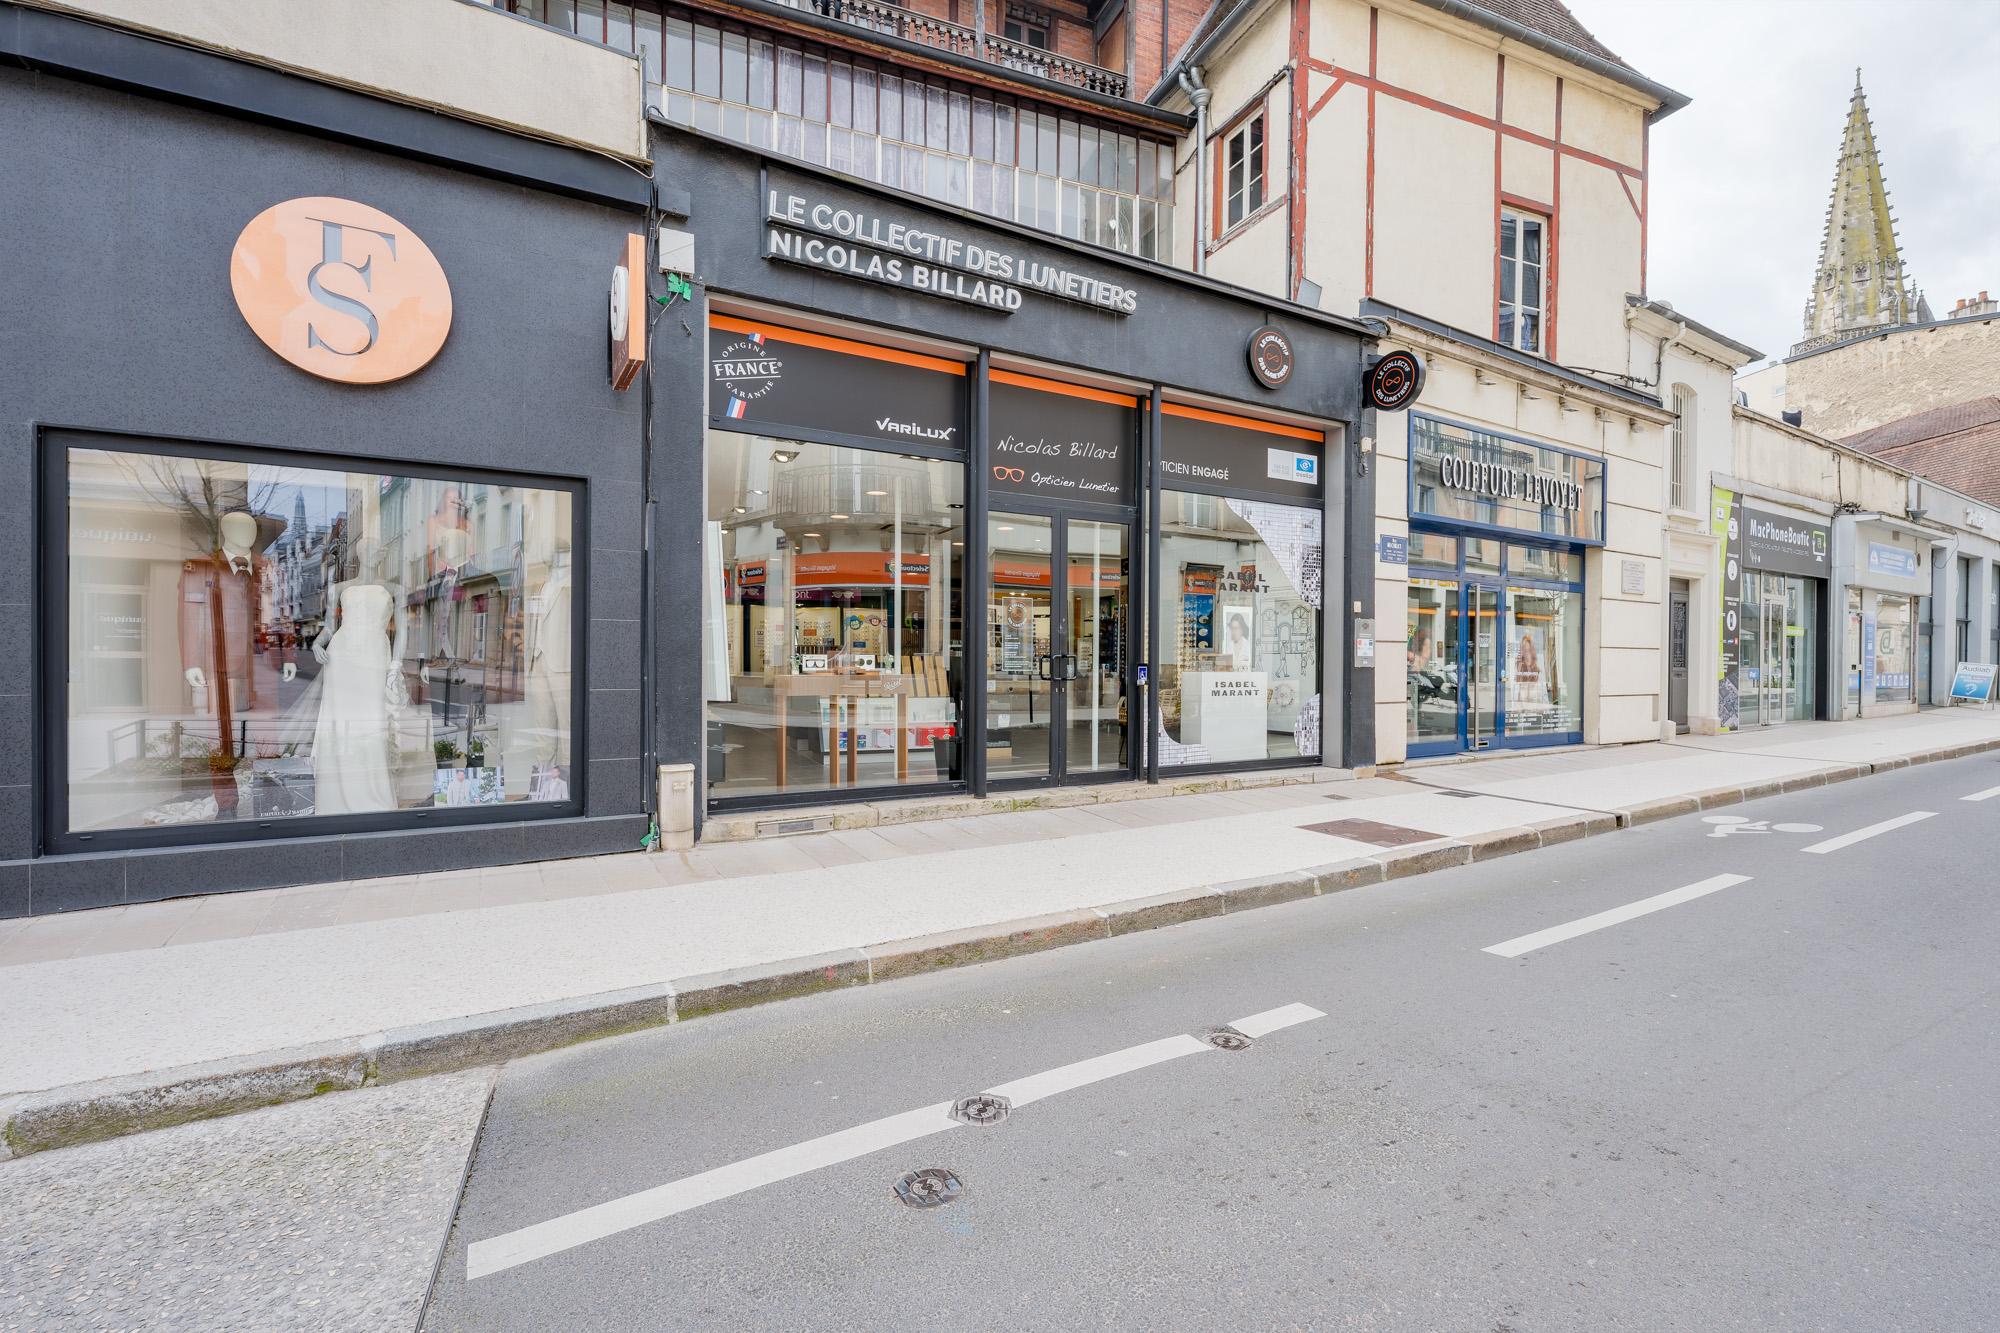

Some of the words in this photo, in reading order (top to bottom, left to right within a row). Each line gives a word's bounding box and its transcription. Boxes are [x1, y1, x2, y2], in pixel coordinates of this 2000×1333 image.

[768, 190, 806, 225] LE
[811, 203, 962, 266] COLLECTIF
[965, 245, 1014, 279] DES
[1018, 260, 1138, 311] LUNETIERS
[769, 230, 903, 282] NICOLAS
[912, 265, 1023, 311] BILLARD
[721, 341, 767, 358] ORIGINE
[725, 380, 774, 399] GARANTIE
[996, 435, 1062, 458] Nicolas
[1069, 441, 1118, 461] Billard
[1031, 471, 1075, 490] Opticien
[1079, 477, 1120, 494] Lunetier
[1192, 466, 1230, 481] ENGAGÉ
[1441, 454, 1519, 499] COIFFURE
[1524, 473, 1584, 511] LEVOYET
[1211, 689, 1260, 697] MARANT
[1215, 680, 1257, 688] ISABEL
